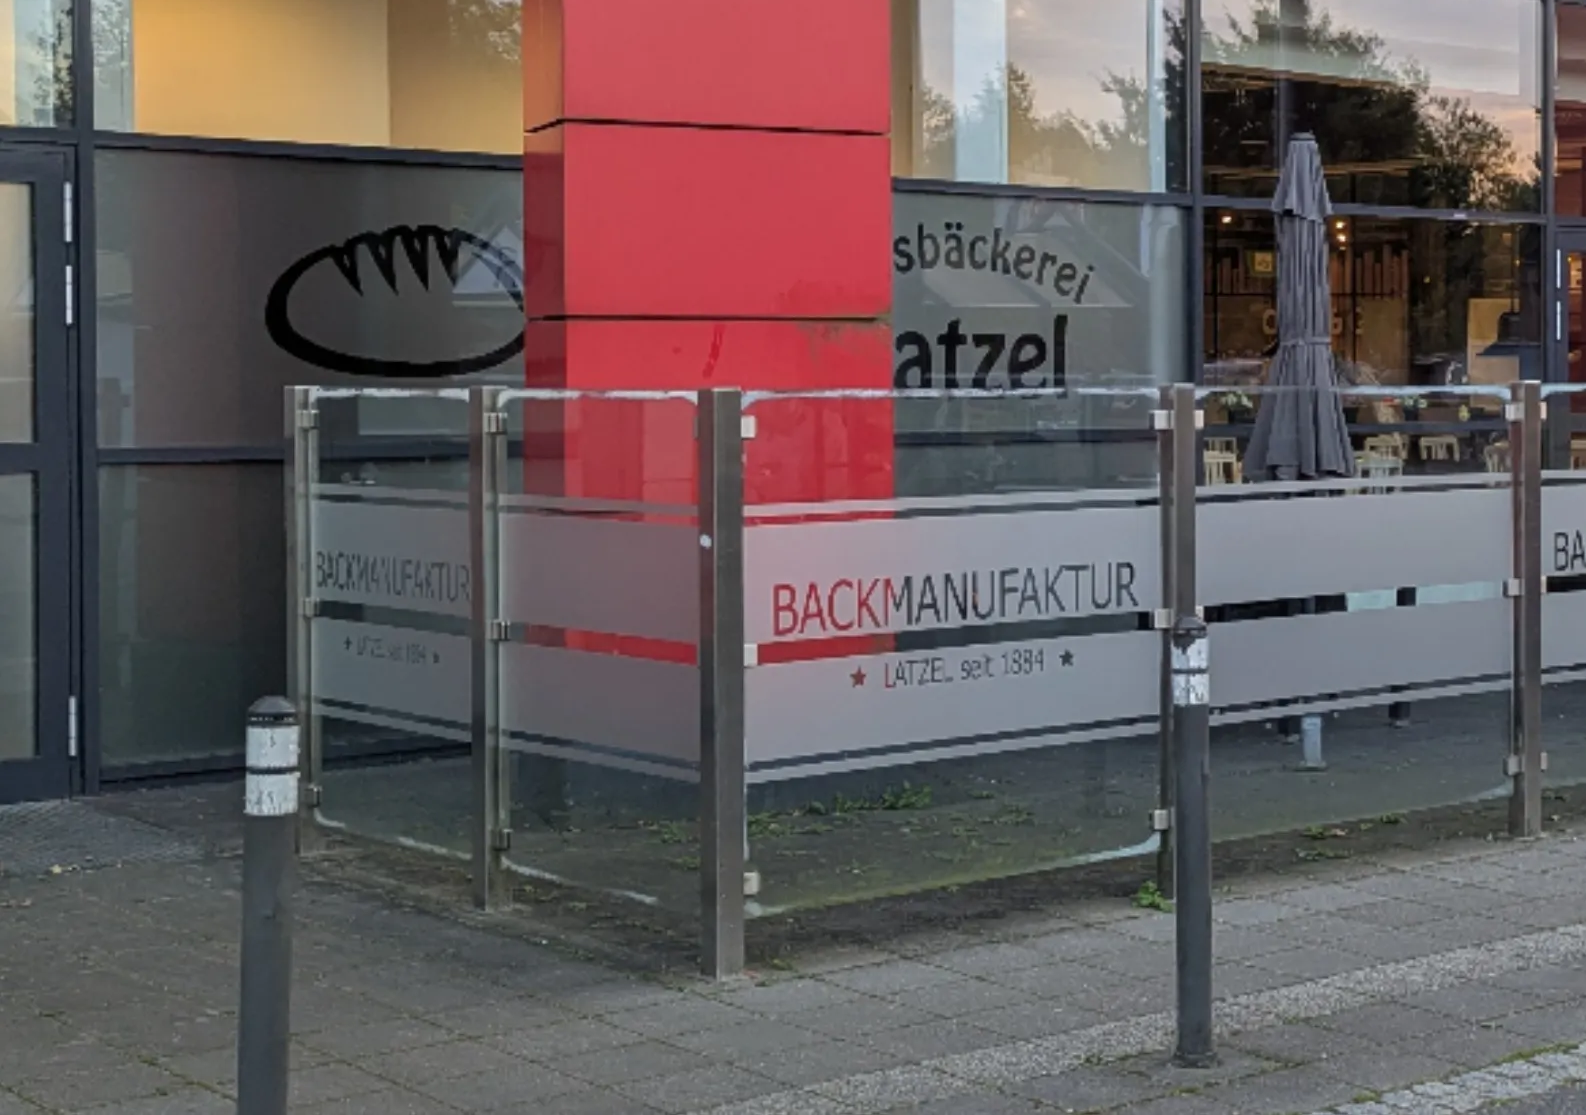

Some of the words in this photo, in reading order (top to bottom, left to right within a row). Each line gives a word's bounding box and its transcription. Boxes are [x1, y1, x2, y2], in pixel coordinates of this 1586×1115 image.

[892, 221, 1096, 304] sbäckerei
[772, 561, 1140, 636] BACKMANUFAKTUR
[884, 657, 954, 689] LATZEL
[960, 653, 995, 681] seit
